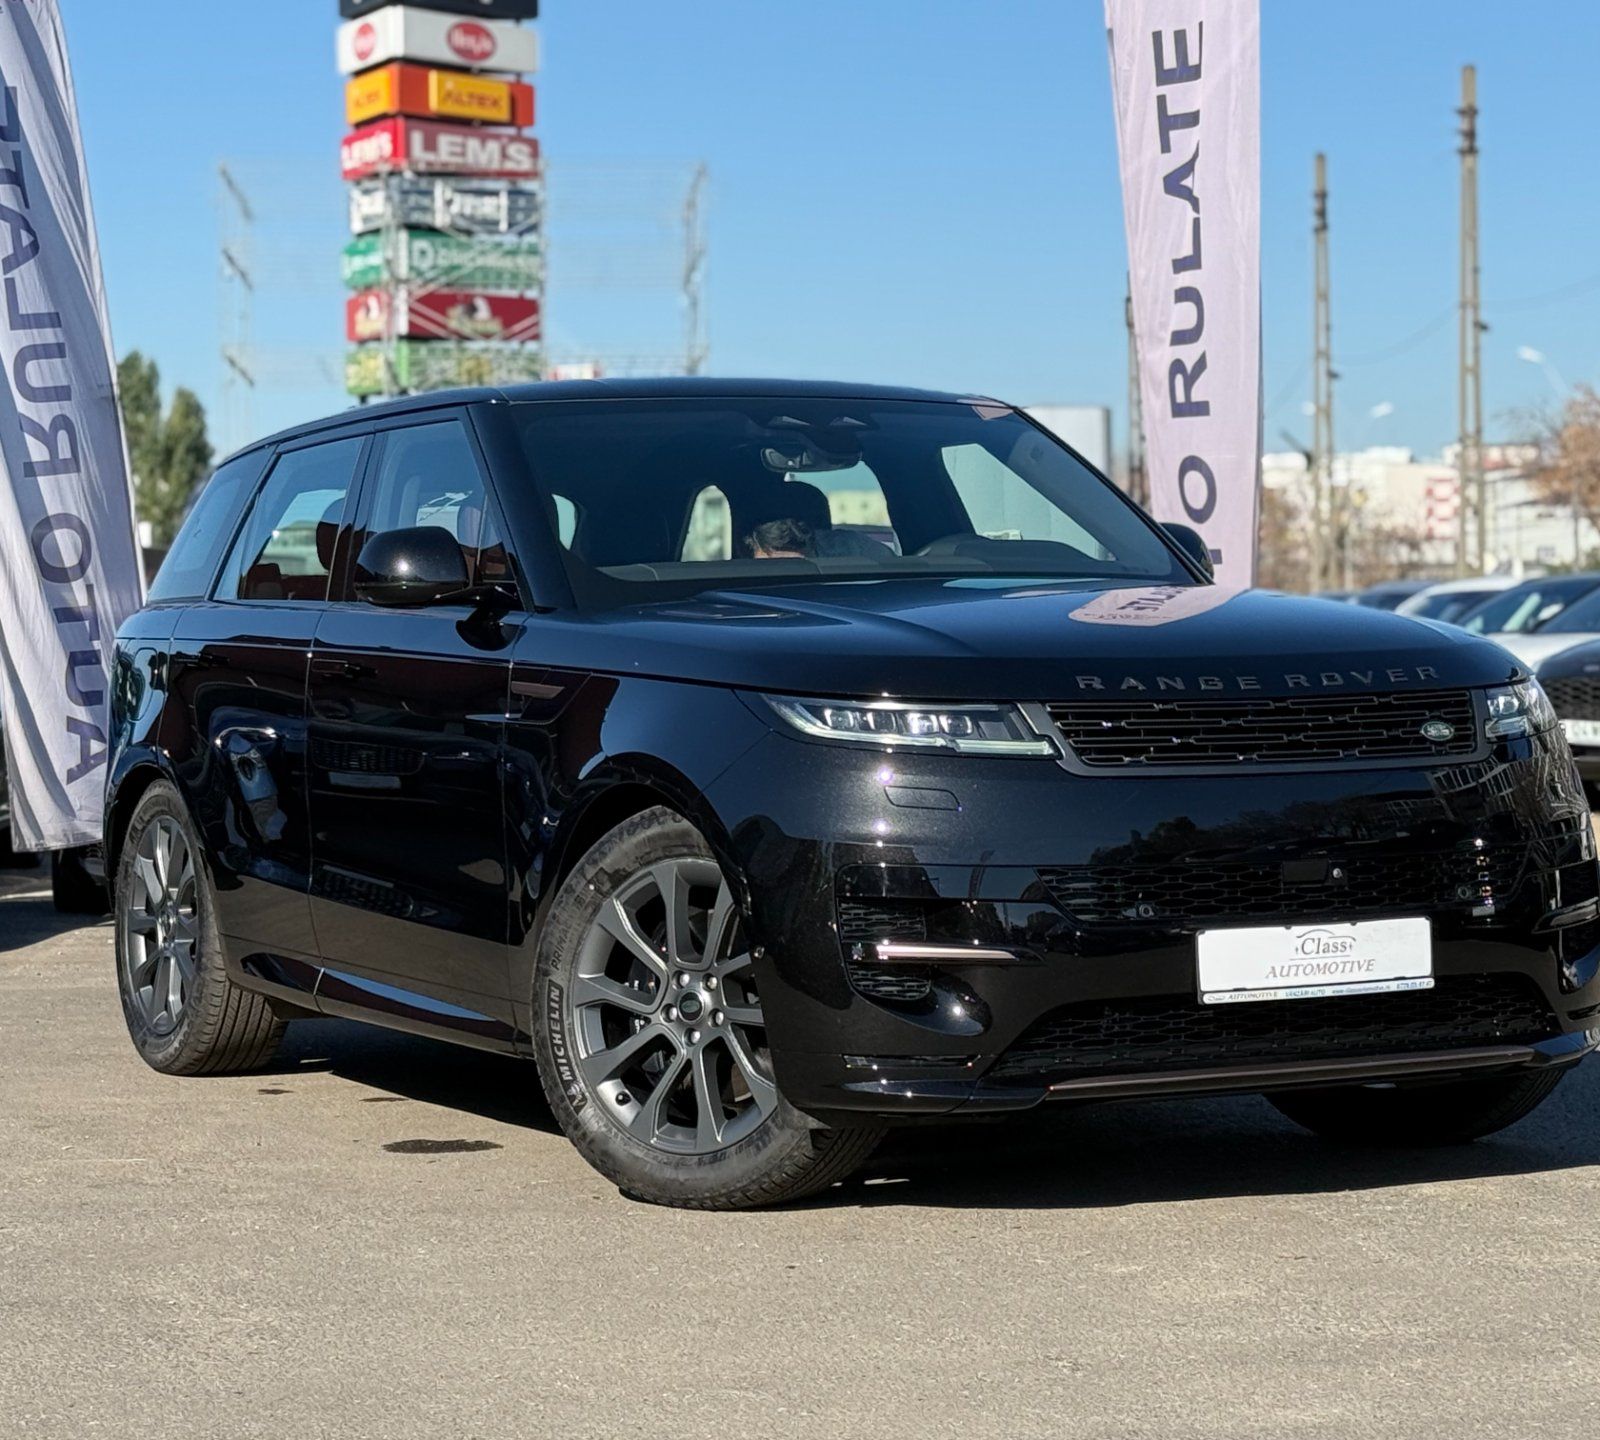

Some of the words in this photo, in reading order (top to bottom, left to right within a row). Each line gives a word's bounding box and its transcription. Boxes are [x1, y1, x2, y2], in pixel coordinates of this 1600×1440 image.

[409, 130, 534, 171] LEM'S
[1151, 20, 1210, 418] RULATE
[1075, 675, 1262, 691] RANGE
[1284, 666, 1439, 688] ROVER
[1301, 937, 1348, 955] Class
[1265, 958, 1376, 979] AUTOMOTIVE
[549, 986, 574, 1081] MICHELIN
